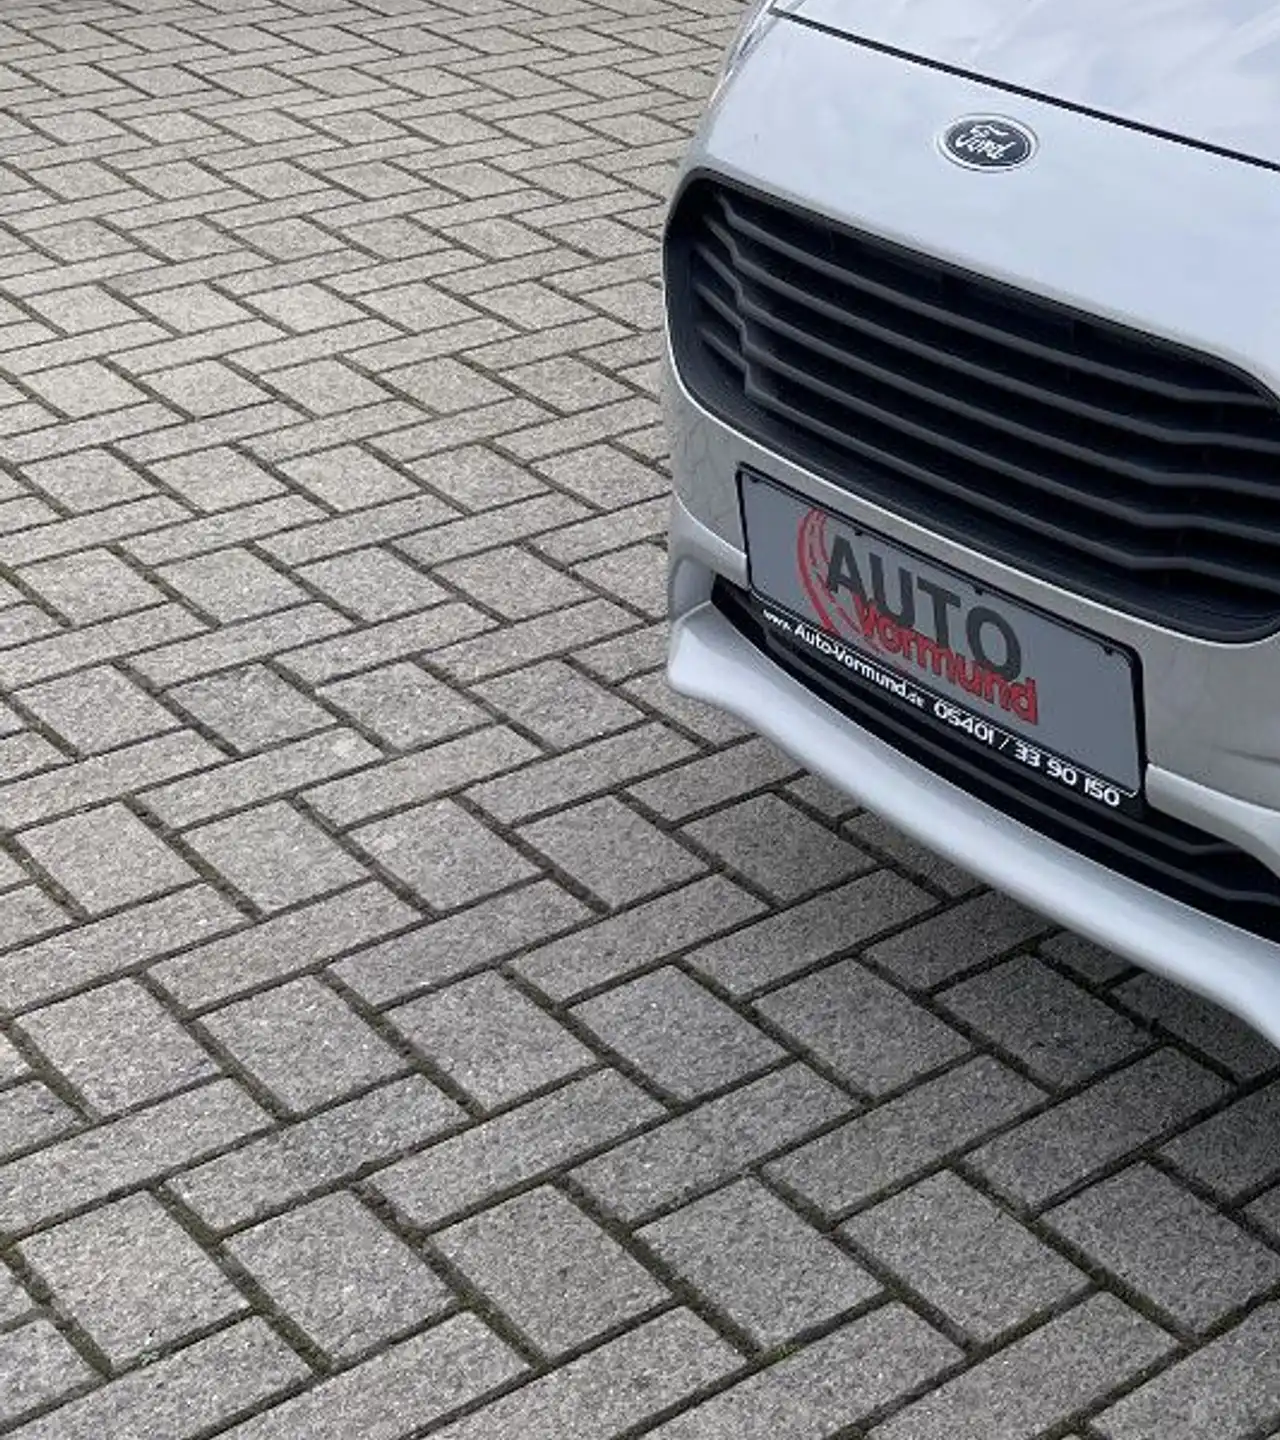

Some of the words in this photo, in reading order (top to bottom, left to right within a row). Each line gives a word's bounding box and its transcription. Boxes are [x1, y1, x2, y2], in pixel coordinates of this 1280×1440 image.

[955, 125, 1017, 159] Ford
[828, 535, 1021, 681] AUTO
[934, 699, 994, 745] 05401
[1014, 742, 1041, 768] 33
[1047, 758, 1078, 787] 90
[1084, 777, 1121, 808] 150
